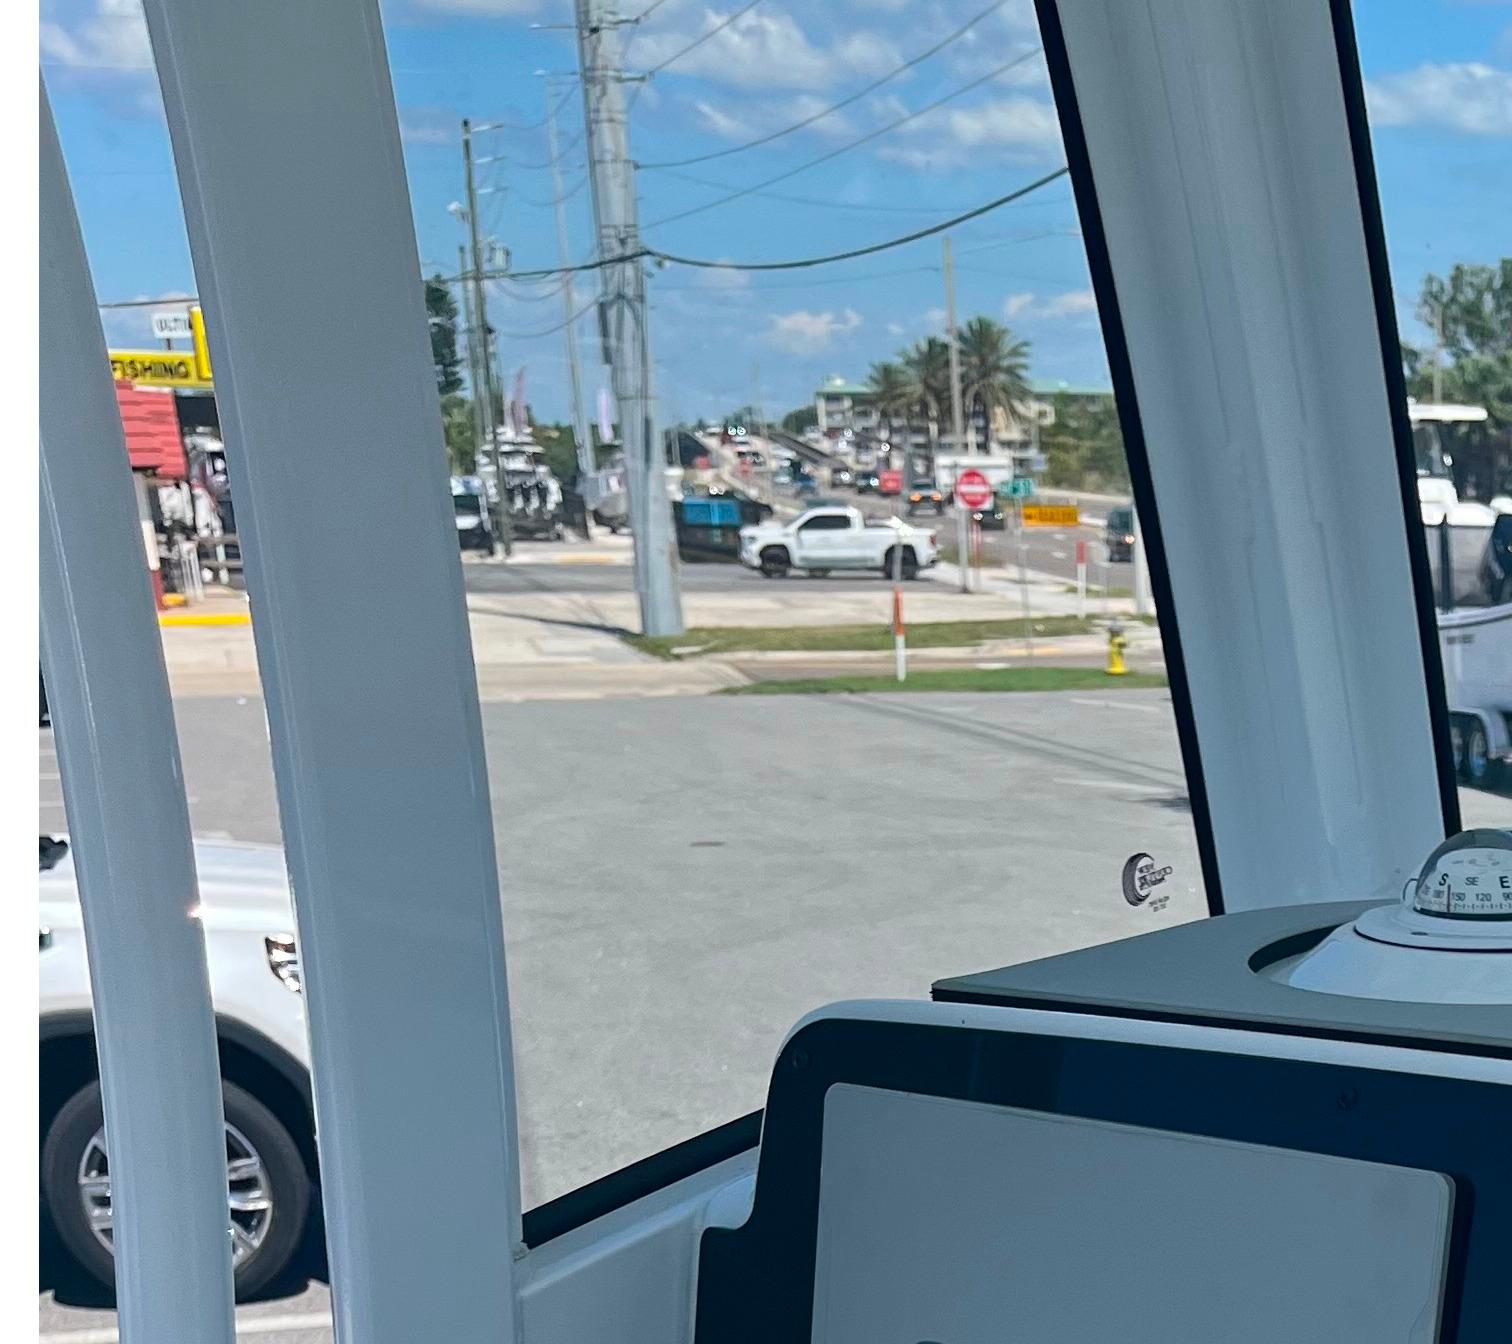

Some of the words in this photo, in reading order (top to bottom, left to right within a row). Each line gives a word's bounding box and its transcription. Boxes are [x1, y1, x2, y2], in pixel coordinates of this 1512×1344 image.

[1438, 873, 1449, 886] S
[1464, 876, 1479, 886] SE
[1499, 876, 1511, 889] E
[1476, 892, 1492, 902] 120
[1502, 892, 1512, 900] 90
